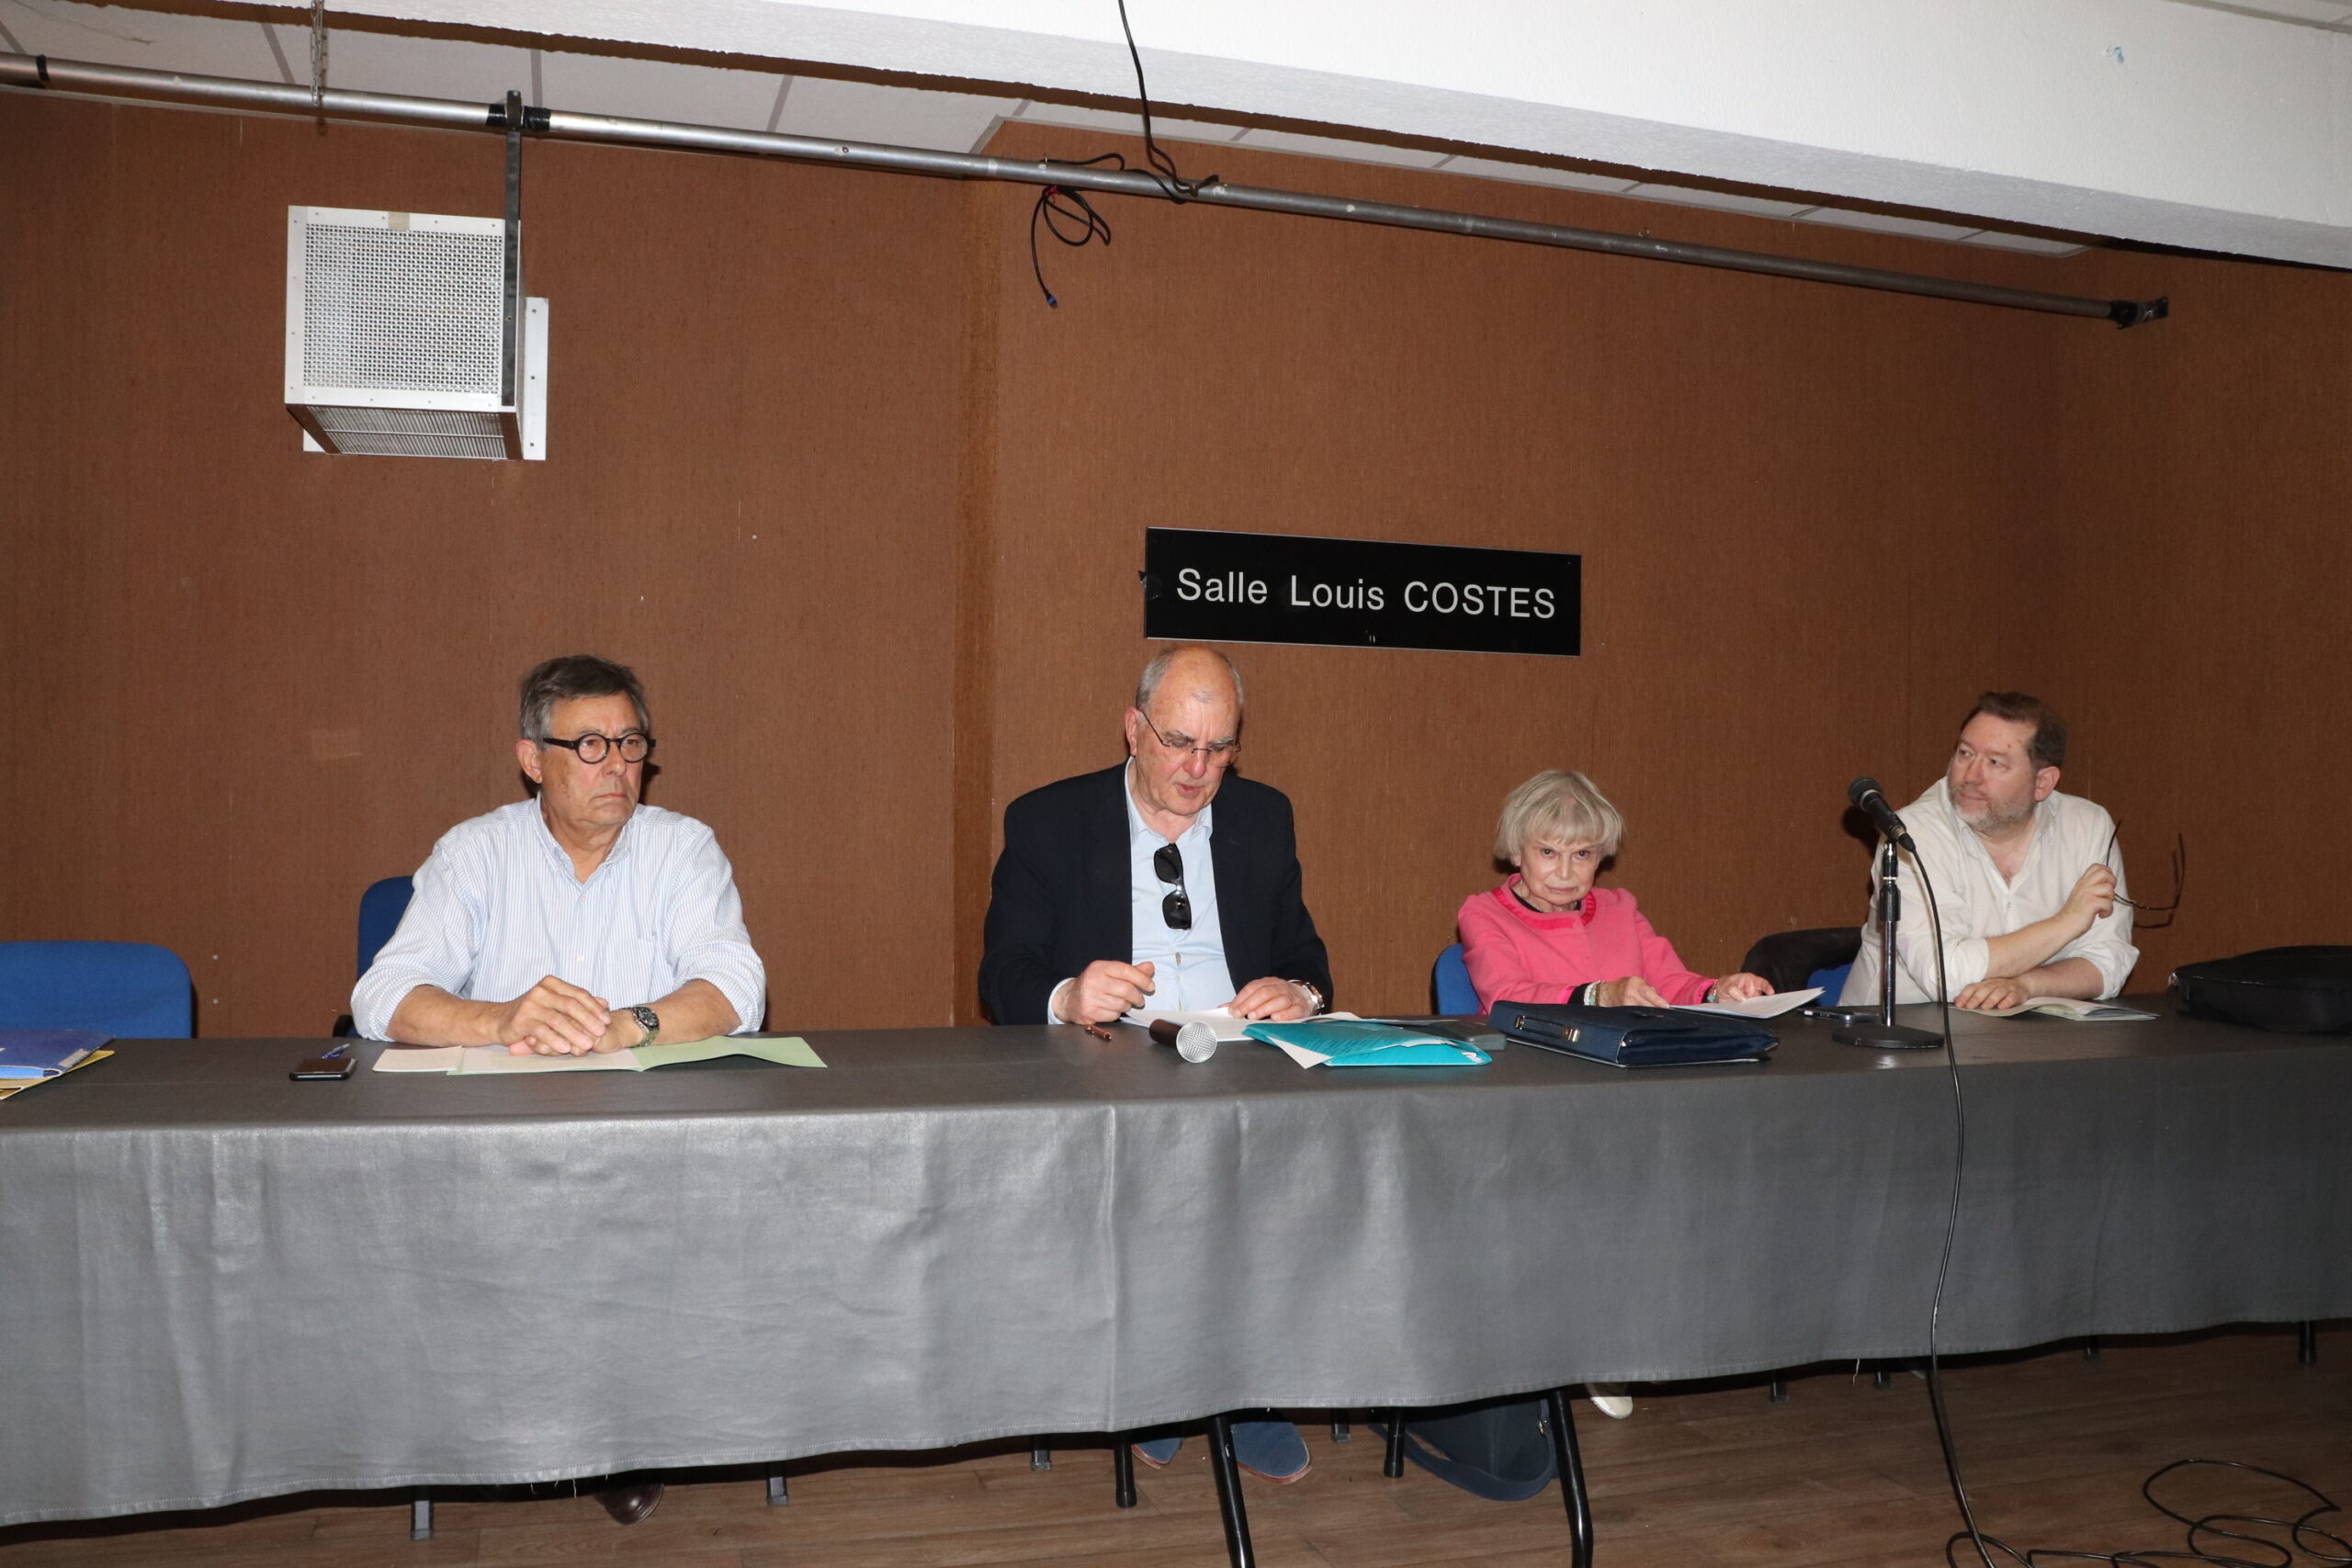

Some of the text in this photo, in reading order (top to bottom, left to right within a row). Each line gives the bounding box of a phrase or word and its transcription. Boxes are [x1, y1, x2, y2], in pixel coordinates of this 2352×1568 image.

[1177, 568, 1555, 619] Salle Louis COSTES
